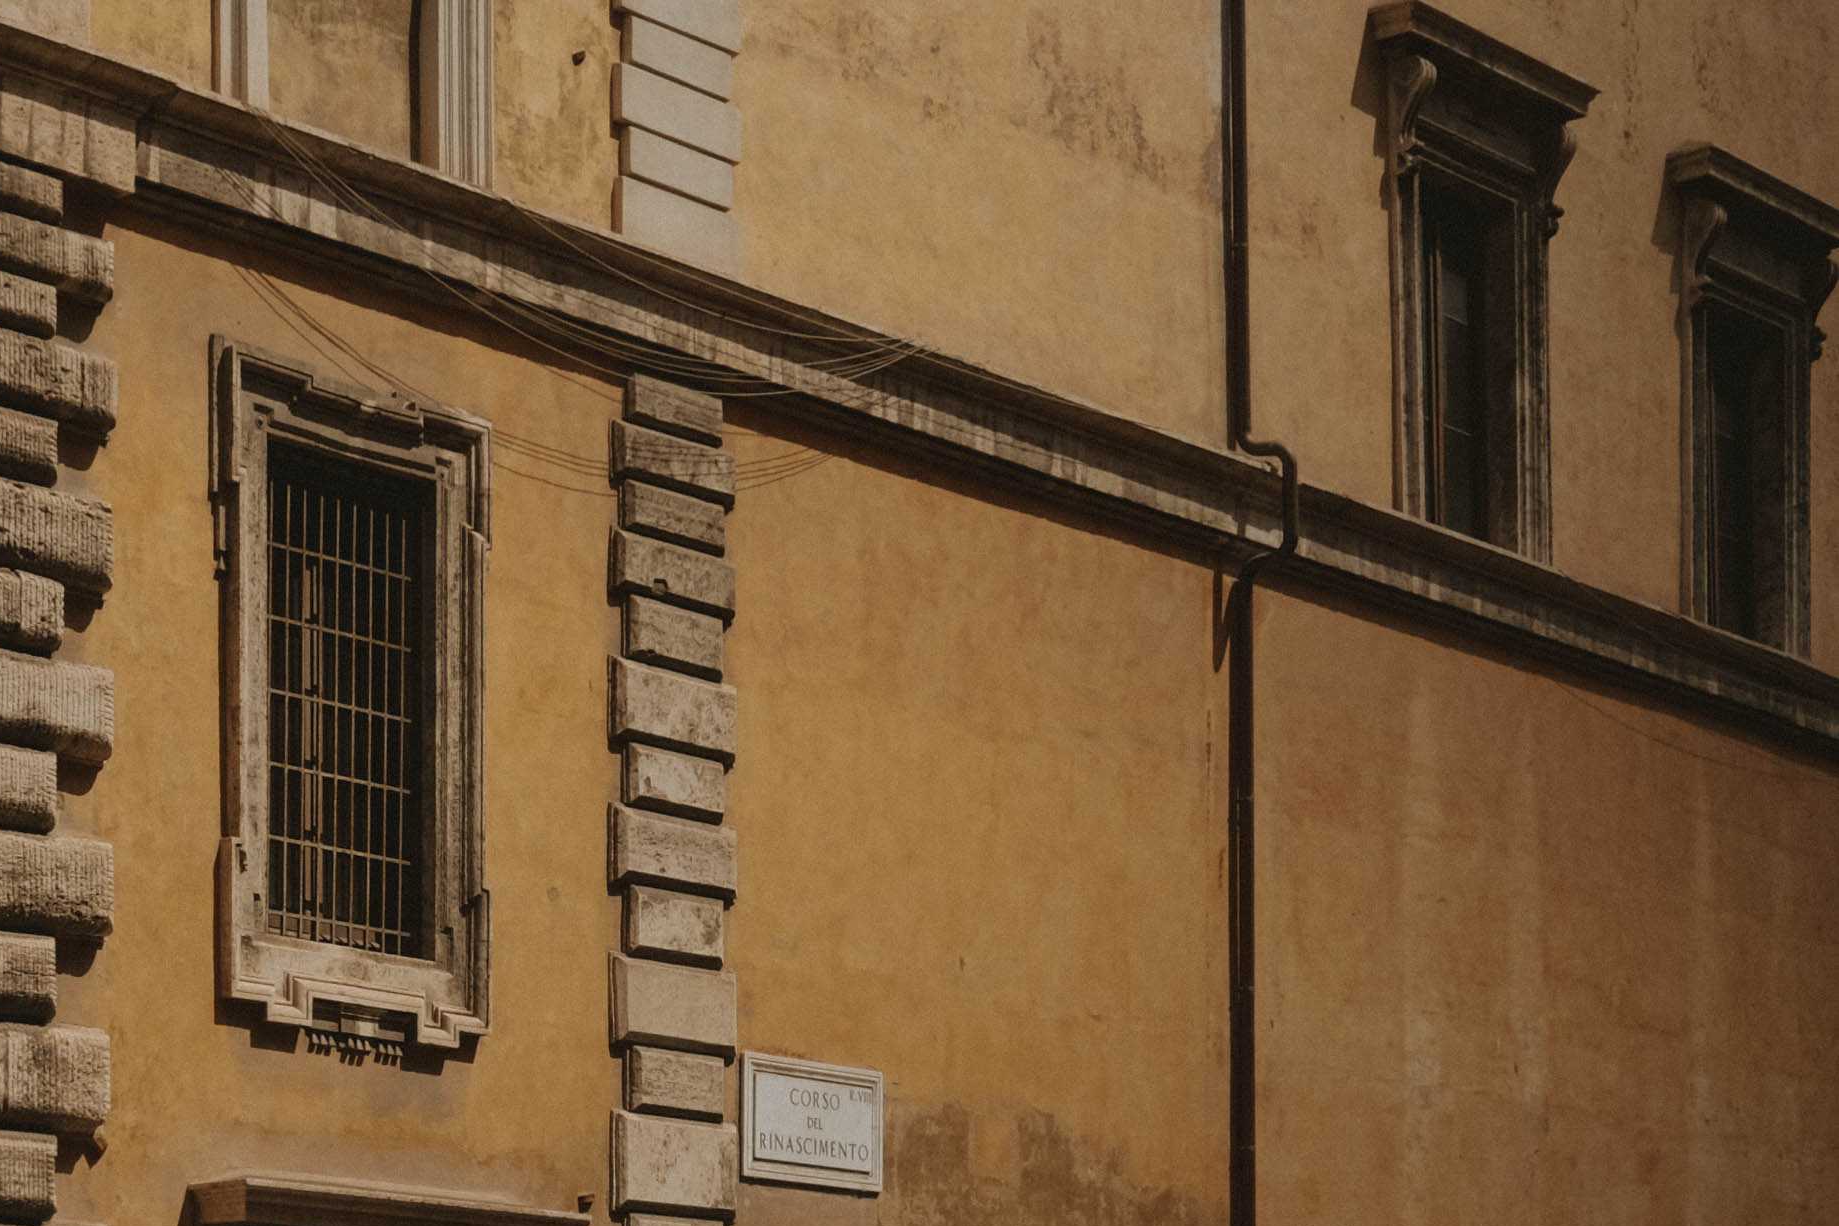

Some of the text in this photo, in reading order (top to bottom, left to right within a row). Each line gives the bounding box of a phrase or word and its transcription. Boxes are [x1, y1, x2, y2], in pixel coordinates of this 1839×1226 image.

[789, 1087, 840, 1111] CORSO
[807, 1116, 823, 1131] DEL
[759, 1132, 869, 1163] RINASCIMENTO
